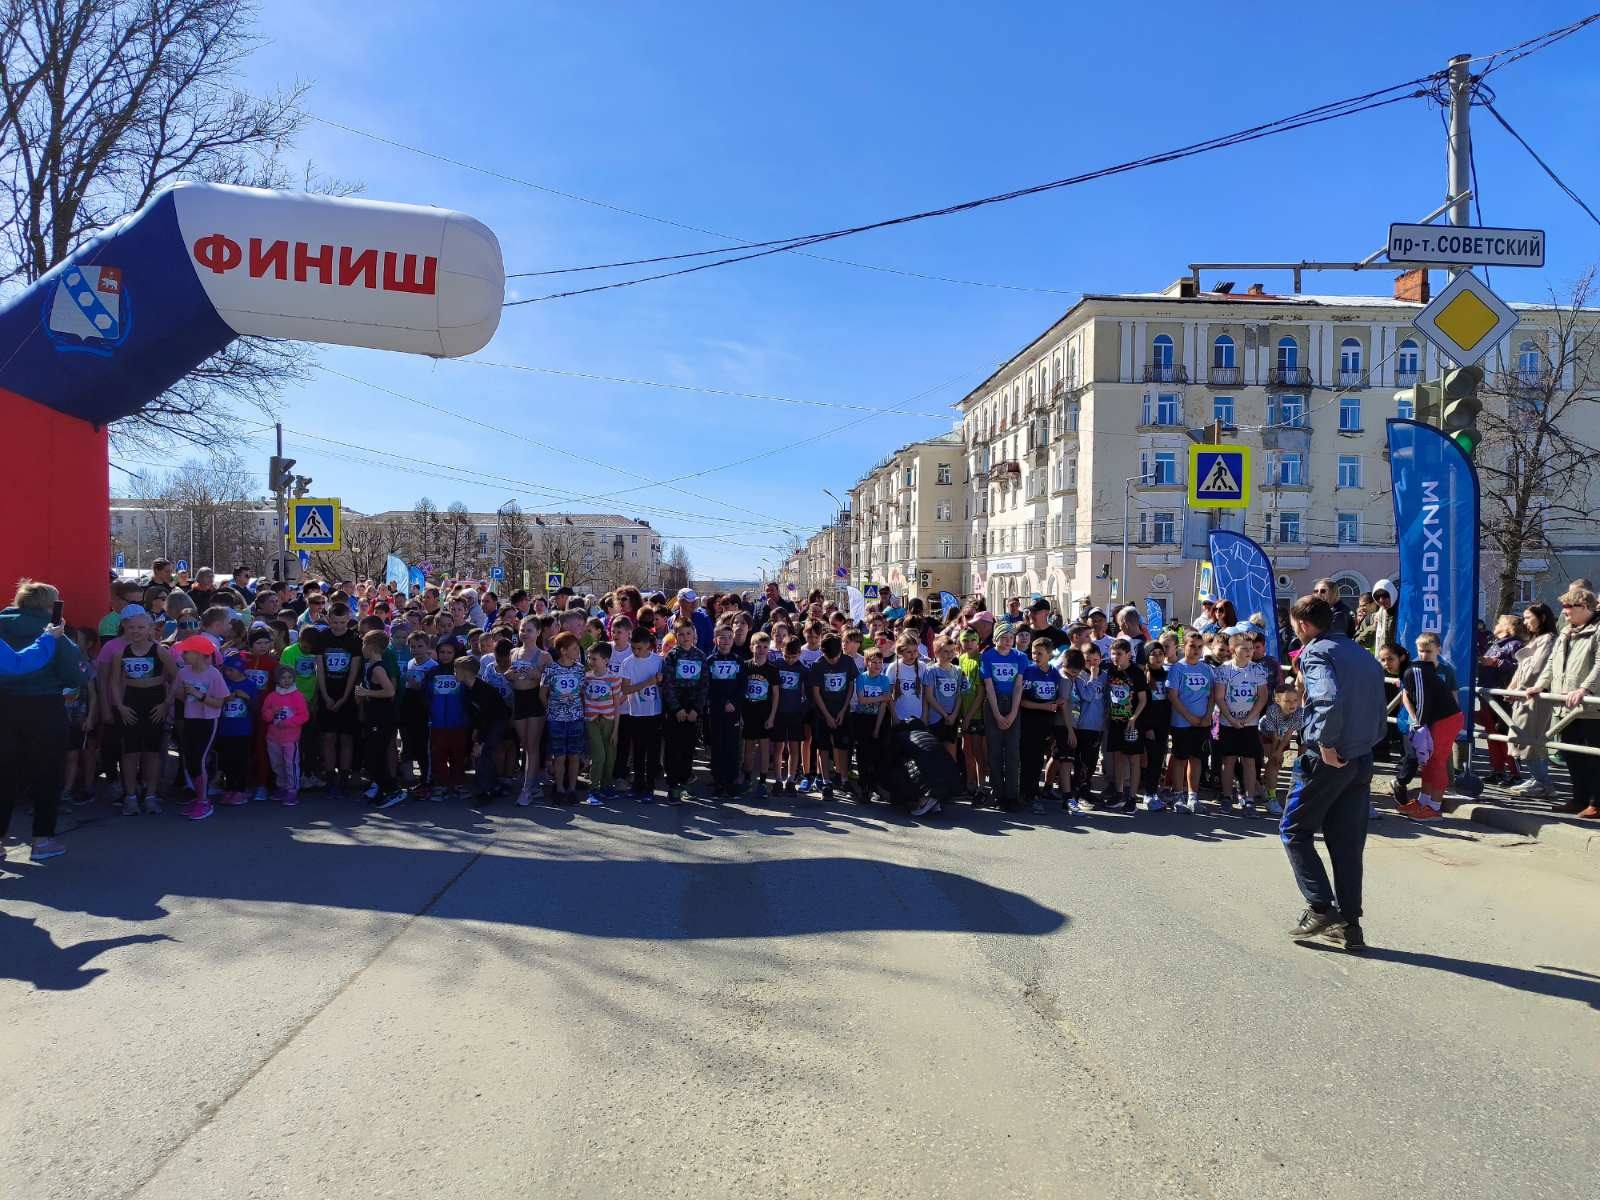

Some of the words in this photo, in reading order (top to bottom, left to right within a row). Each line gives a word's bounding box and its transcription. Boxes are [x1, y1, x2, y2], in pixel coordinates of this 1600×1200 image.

[193, 233, 438, 295] ФИНИШ
[328, 659, 346, 667] 175
[682, 665, 696, 674] 90
[718, 665, 732, 674] 77
[996, 668, 1014, 677] 164
[560, 679, 575, 689] 93
[830, 678, 842, 687] 57
[588, 685, 606, 694] 136
[943, 683, 956, 692] 85
[1234, 689, 1253, 697] 101
